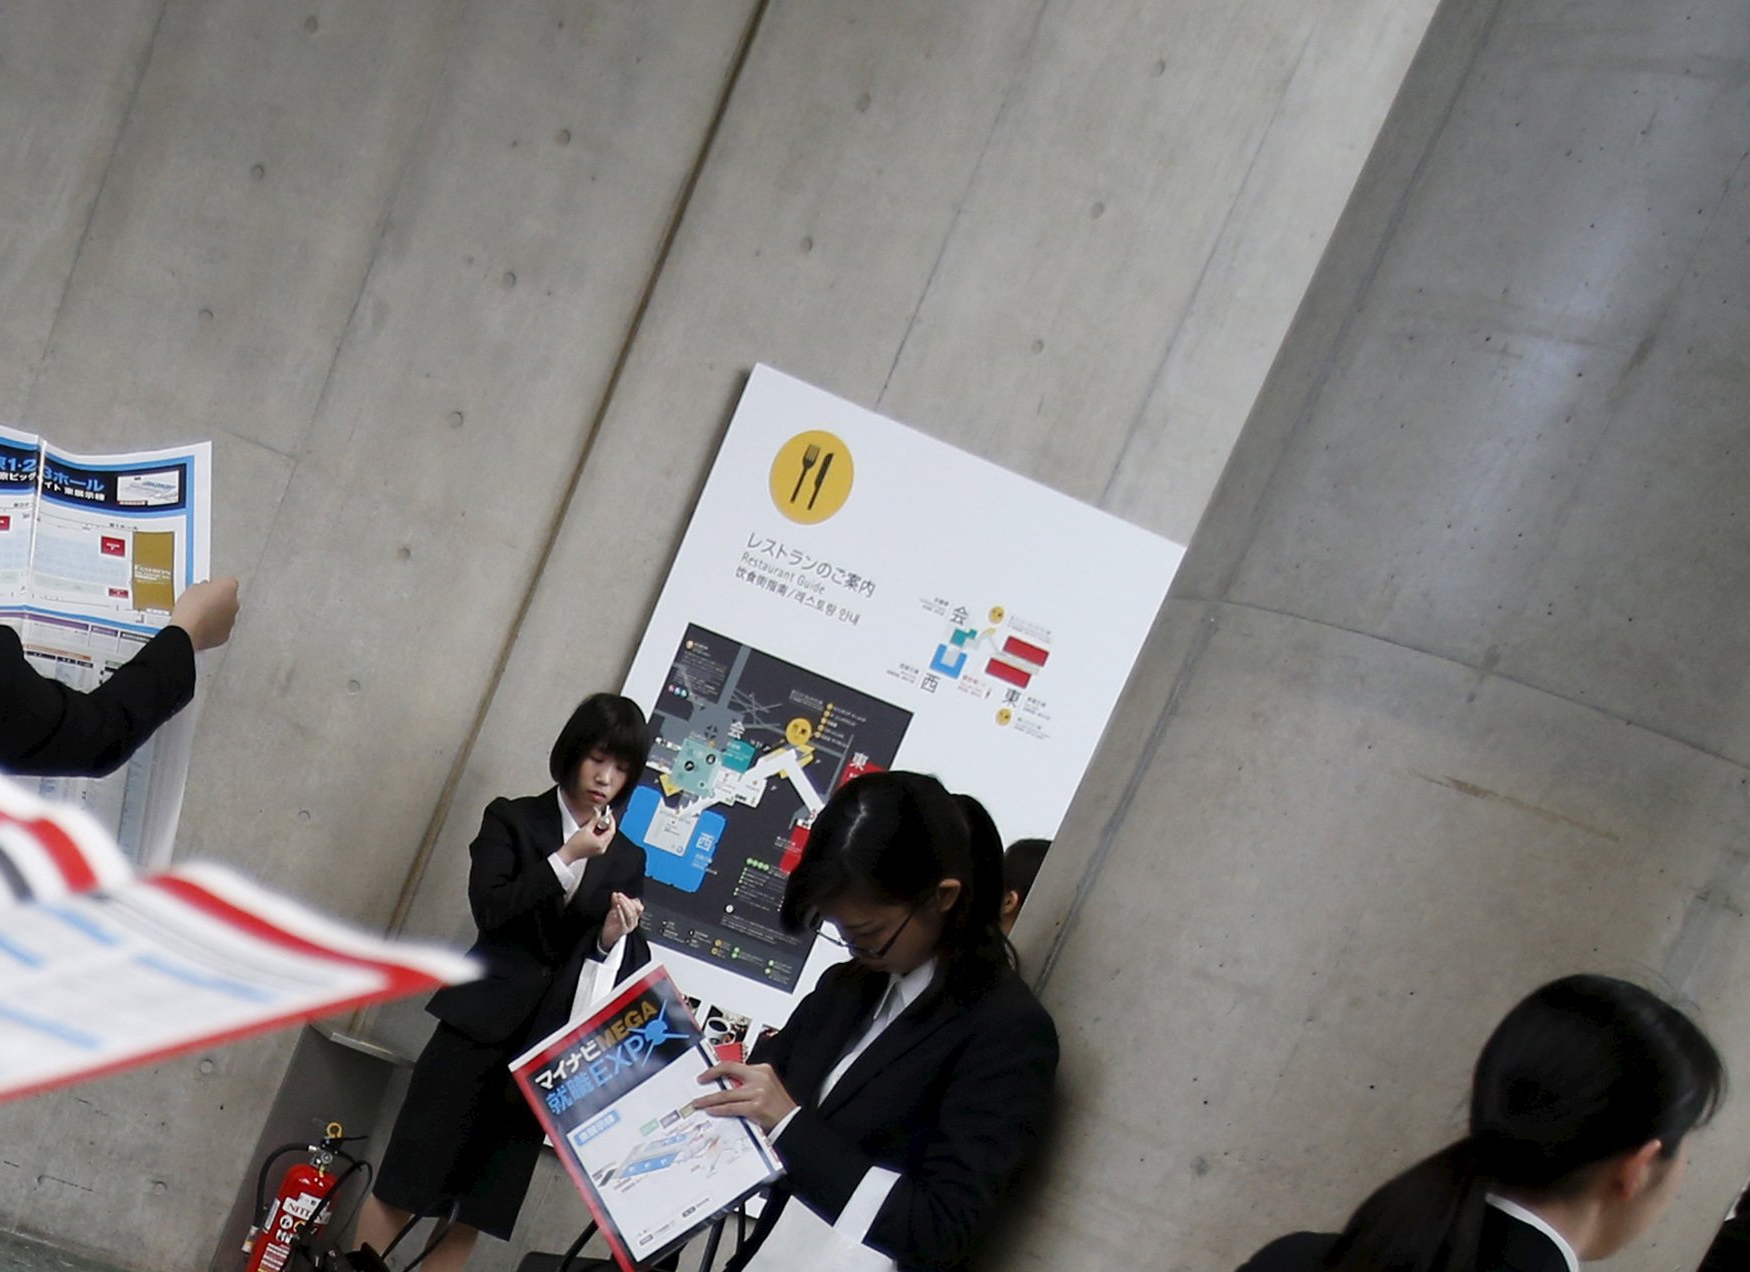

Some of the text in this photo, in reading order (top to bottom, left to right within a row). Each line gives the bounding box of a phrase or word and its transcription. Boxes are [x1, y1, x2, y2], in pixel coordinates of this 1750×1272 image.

[741, 551, 827, 595] Restaurant Guide
[746, 532, 877, 599] レストランのご案内
[920, 672, 941, 694] 西
